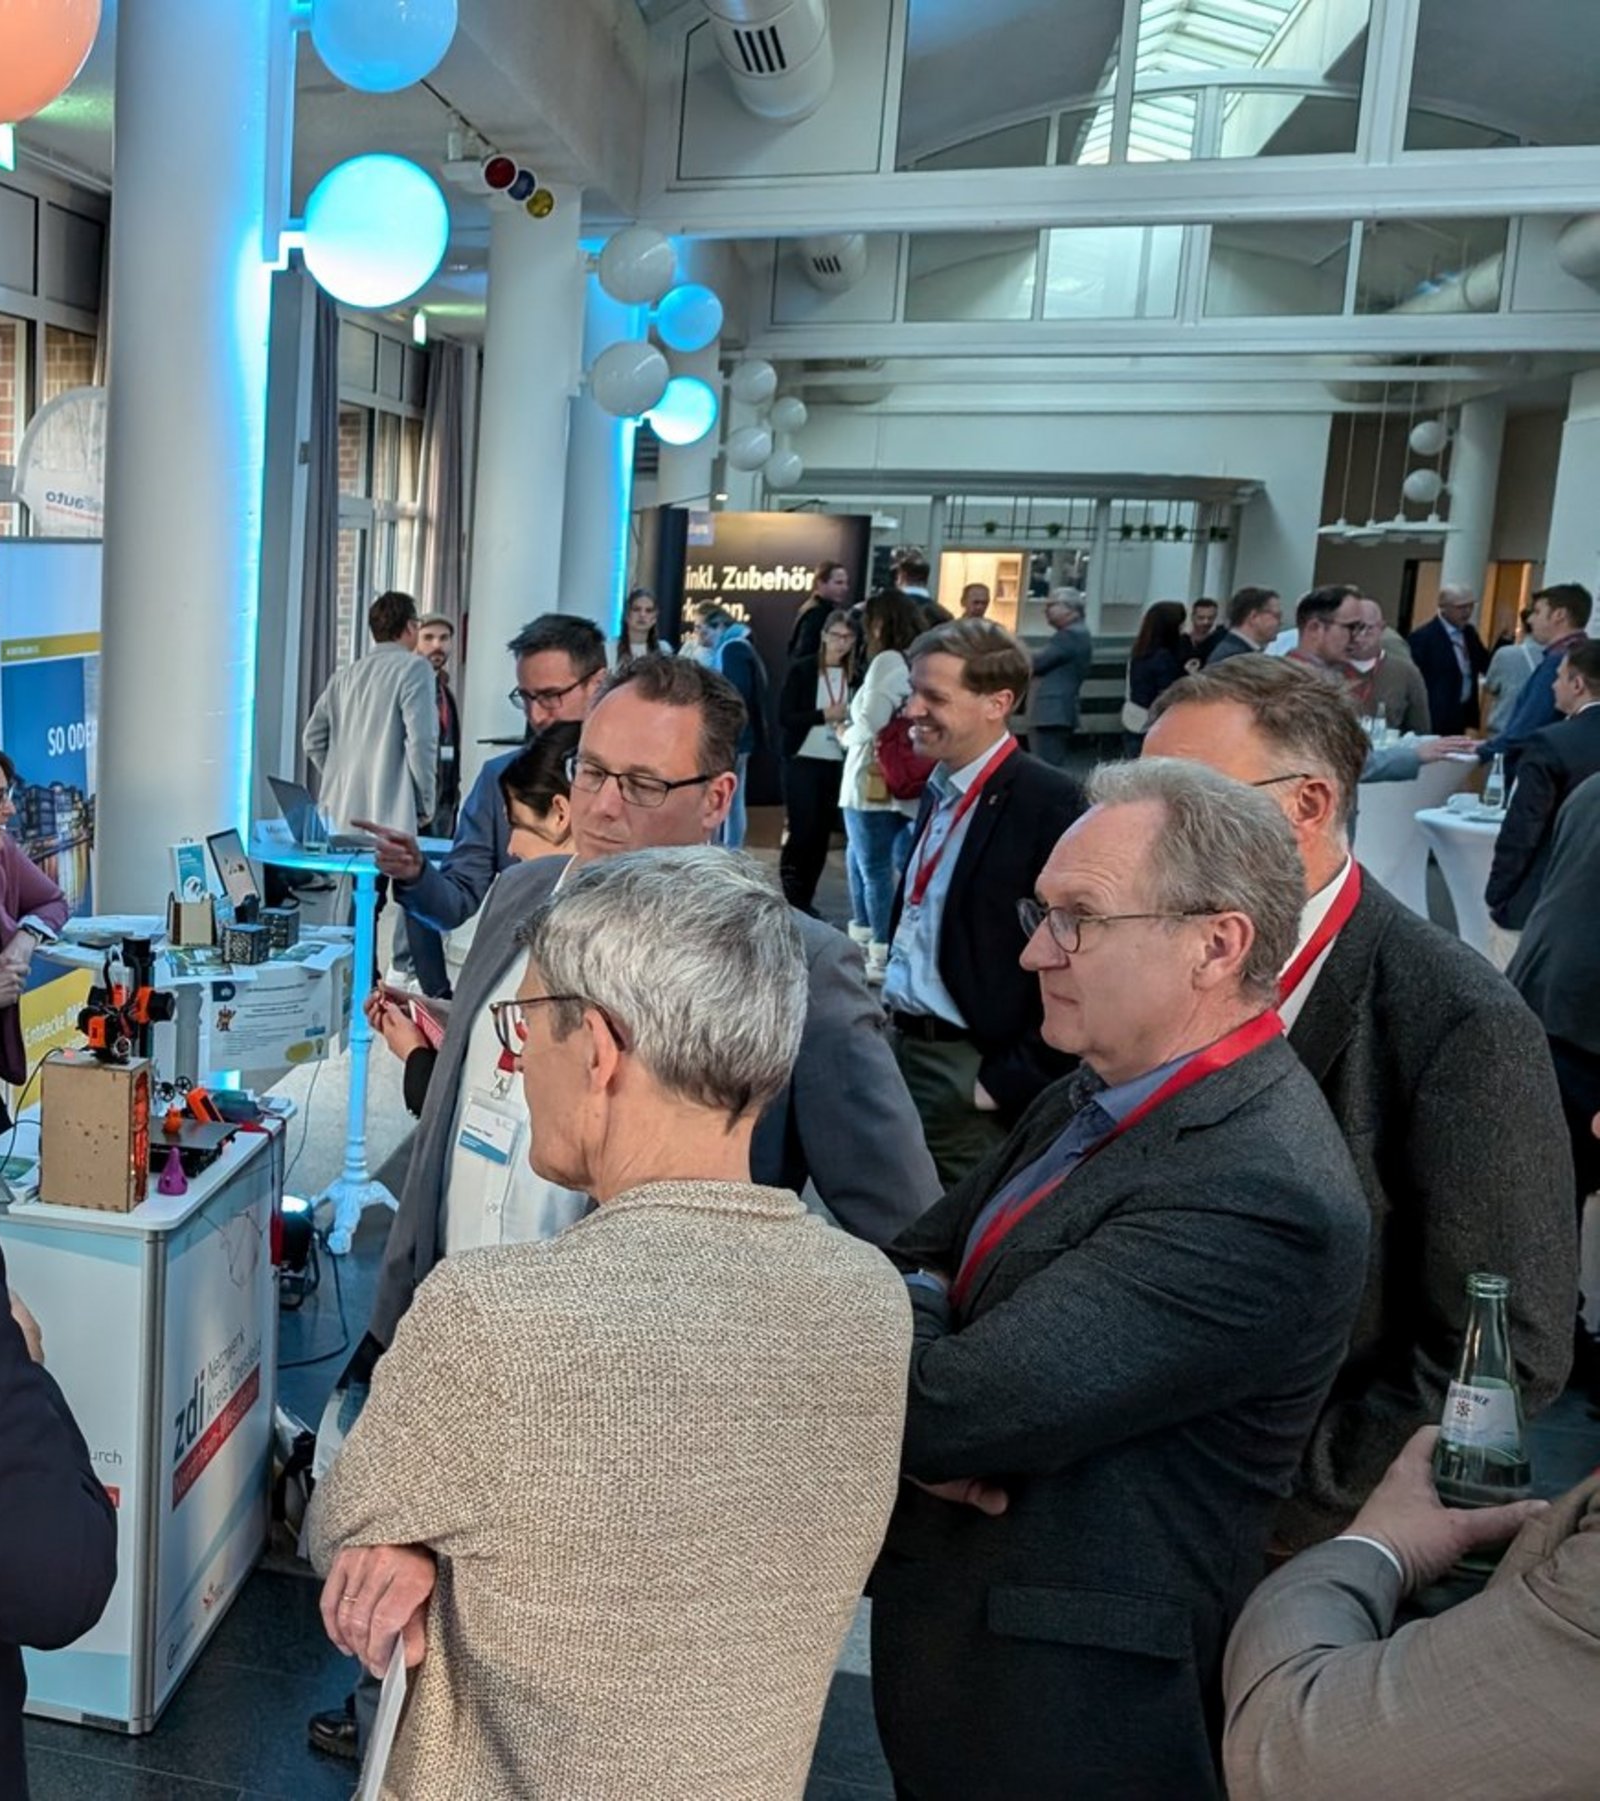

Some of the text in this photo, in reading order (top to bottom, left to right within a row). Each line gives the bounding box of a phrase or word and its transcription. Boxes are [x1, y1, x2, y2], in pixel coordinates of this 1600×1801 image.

[721, 565, 815, 591] Zubehör
[48, 726, 65, 757] SO
[173, 1368, 206, 1464] zdi
